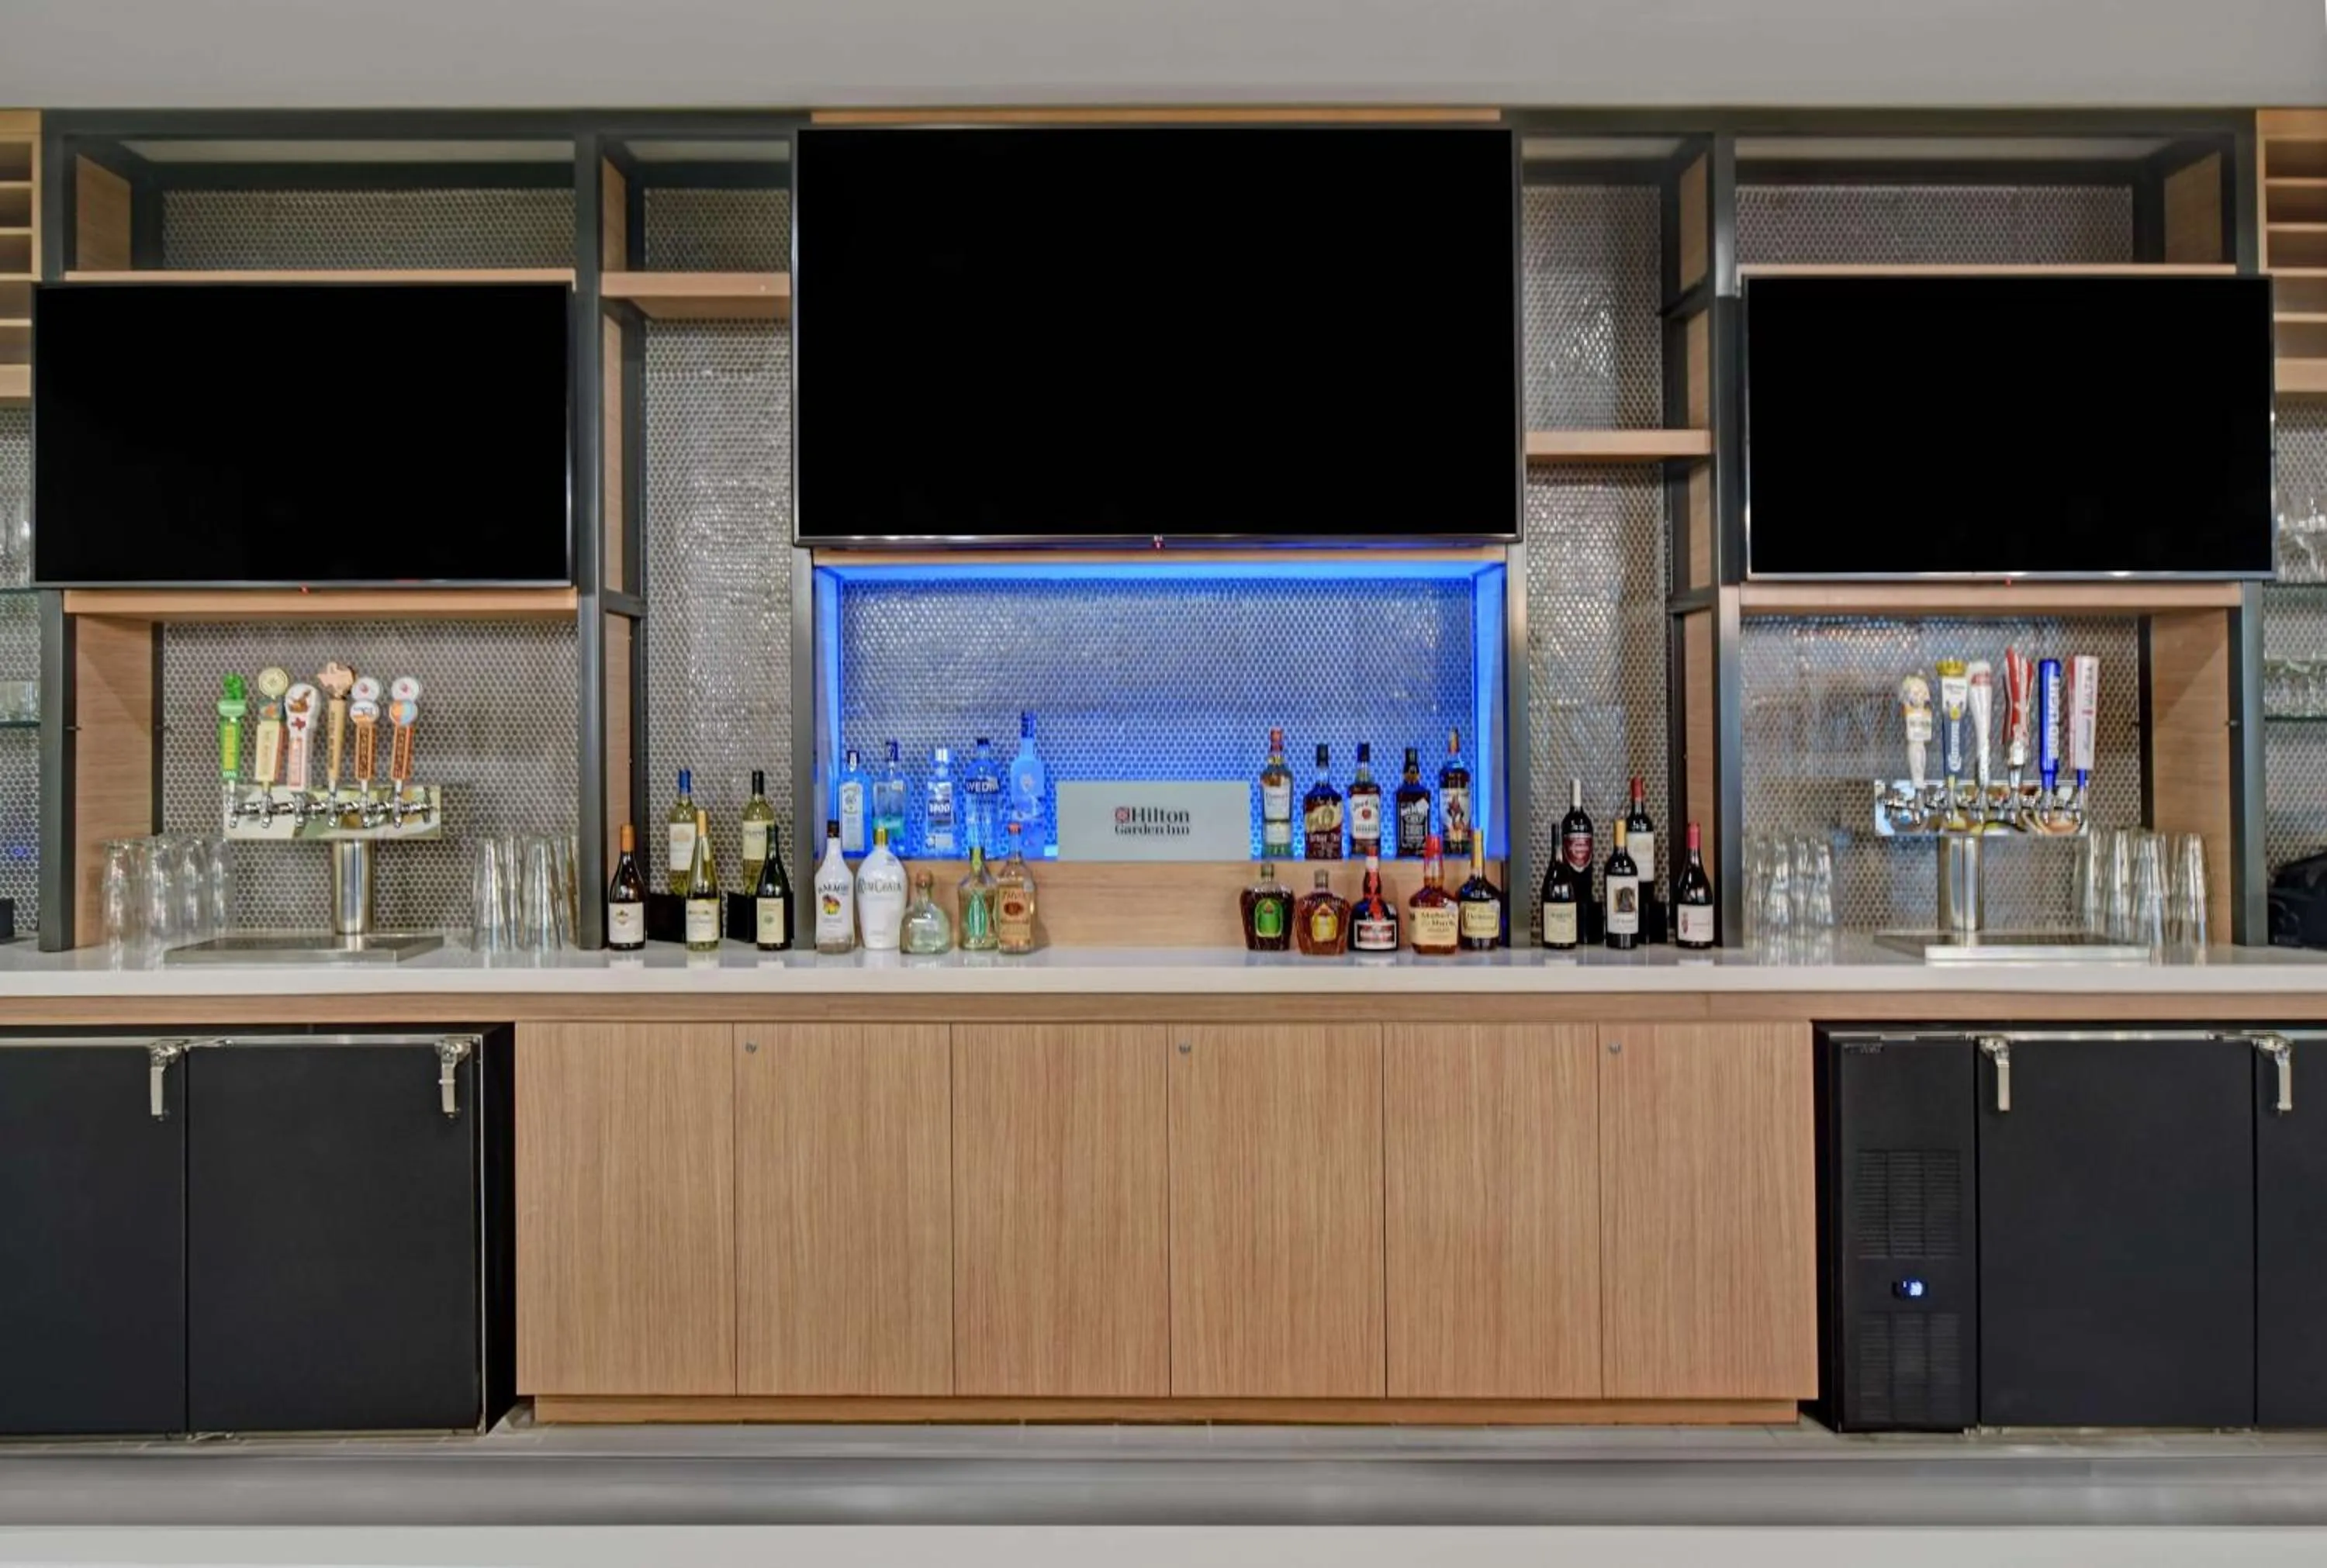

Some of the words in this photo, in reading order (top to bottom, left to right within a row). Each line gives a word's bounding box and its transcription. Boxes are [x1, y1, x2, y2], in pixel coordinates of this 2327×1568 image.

[2049, 677, 2059, 723] LIGHT
[2049, 726, 2059, 759] BUD
[1132, 806, 1190, 823] Hilton
[1115, 824, 1164, 835] Garden
[1167, 824, 1189, 835] Inn
